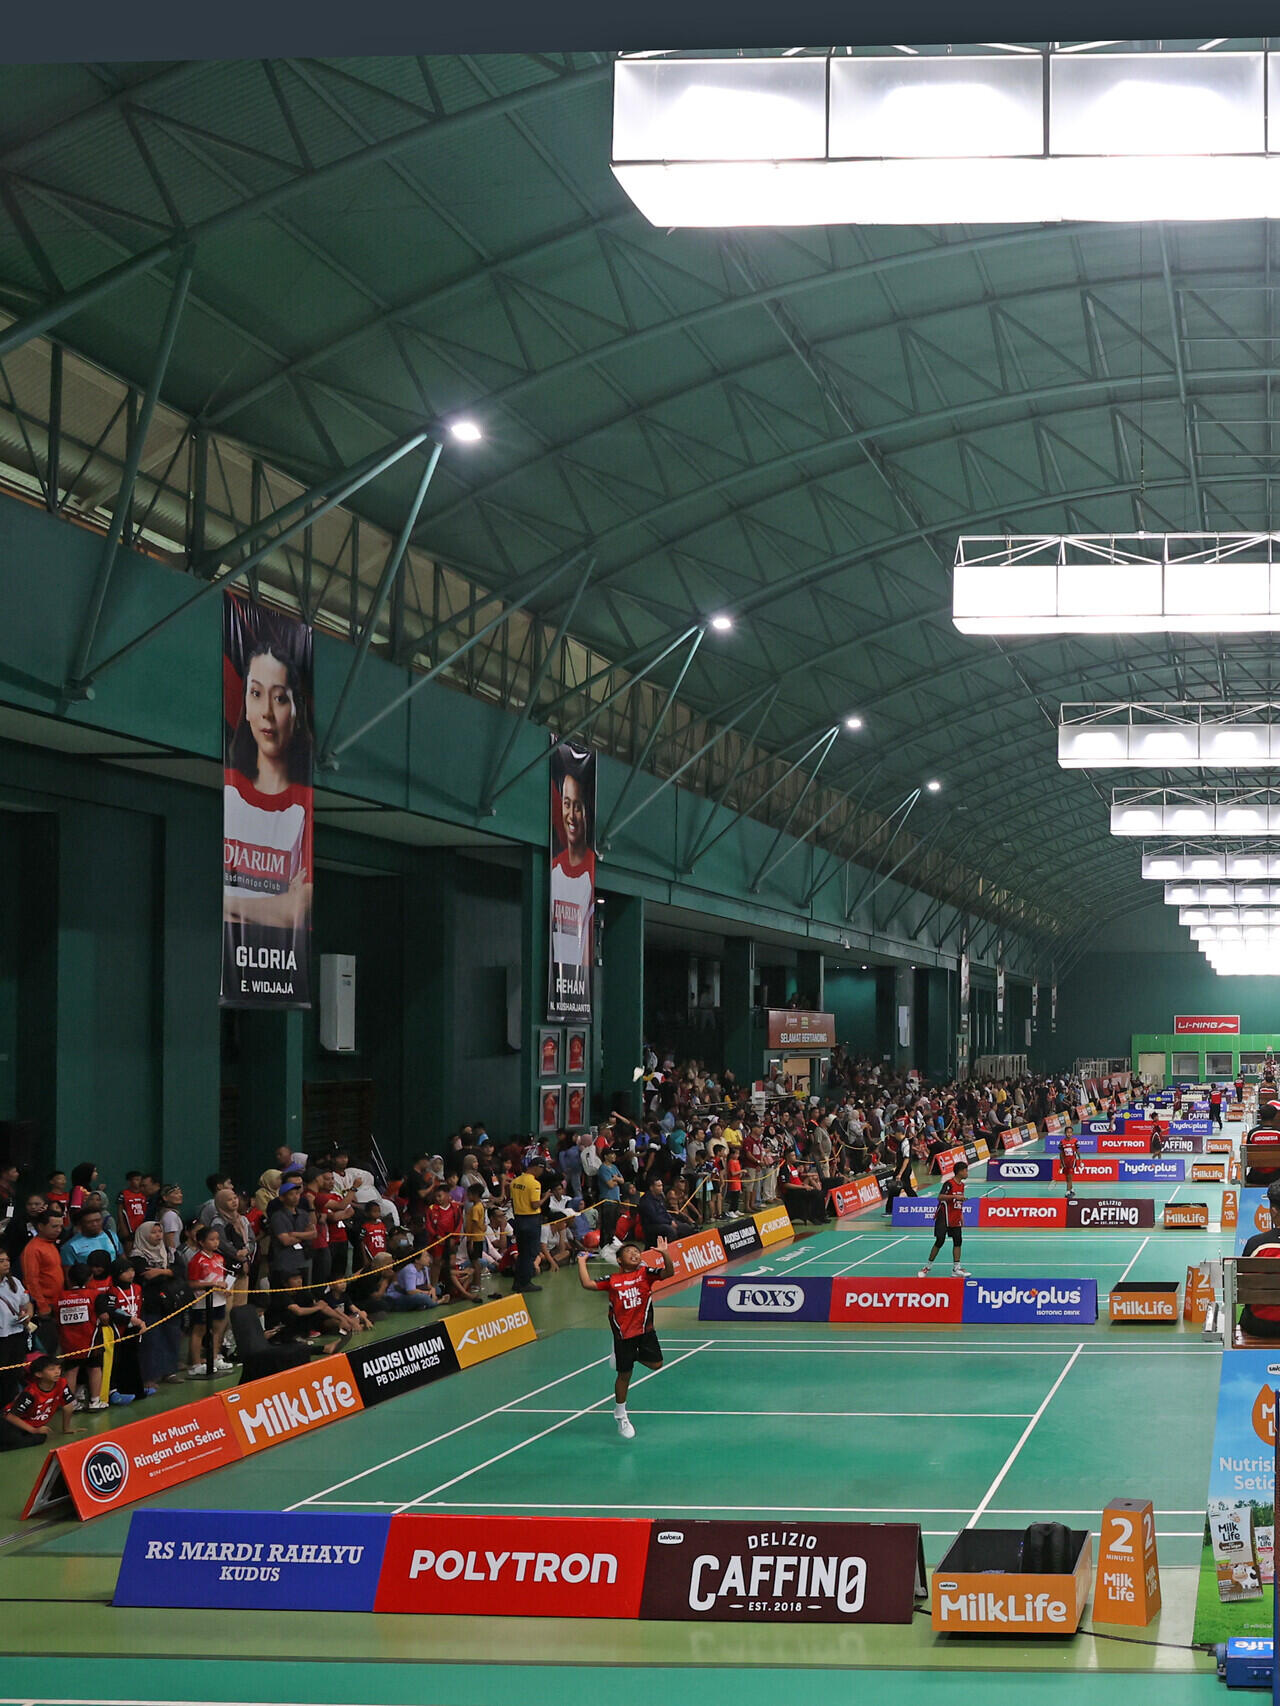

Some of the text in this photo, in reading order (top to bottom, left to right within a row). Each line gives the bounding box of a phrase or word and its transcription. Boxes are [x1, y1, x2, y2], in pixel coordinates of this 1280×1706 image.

[236, 945, 297, 971] GLORIA
[252, 980, 294, 995] WIDJAJA
[556, 978, 585, 996] REHAN
[1177, 1021, 1218, 1029] LI-NING
[1102, 1140, 1145, 1148] POLYTRON
[1125, 1162, 1176, 1175] hydroplus
[1225, 1193, 1234, 1204] 2
[988, 1207, 1057, 1217] POLYTRON
[1080, 1207, 1139, 1225] CAFFINO
[1166, 1213, 1206, 1224] MilkLife
[682, 1239, 725, 1273] MilkLife
[1197, 1272, 1209, 1289] 2
[618, 1287, 641, 1300] Milk
[845, 1292, 949, 1308] POLYTRON
[977, 1286, 1080, 1308] hydroplus
[623, 1297, 642, 1309] Life
[1113, 1301, 1173, 1316] MilkLife
[63, 1312, 84, 1321] 0787
[475, 1309, 530, 1343] HUNDRED
[362, 1335, 446, 1379] AUDISI UMUM
[376, 1354, 441, 1387] PB DJARUM 2025
[238, 1374, 356, 1445] MilkLife
[151, 1418, 200, 1446] Air Murni
[133, 1446, 173, 1468] Ringan
[173, 1438, 196, 1454] dan
[195, 1427, 227, 1447] Sehat
[1219, 1456, 1275, 1472] Nutrisi
[90, 1461, 122, 1486] Cleo
[1109, 1517, 1133, 1554] 2
[1143, 1513, 1153, 1551] 2
[1218, 1522, 1239, 1534] Milk
[1222, 1531, 1241, 1542] Life
[747, 1531, 818, 1551] DELIZIO
[144, 1540, 365, 1565] RS MARDI RAHAYU
[1106, 1553, 1135, 1563] MINUTES
[218, 1565, 281, 1582] KUDUS
[408, 1549, 619, 1584] POLYTRON
[688, 1554, 867, 1614] CAFFINO
[1103, 1571, 1134, 1589] Milk
[1108, 1586, 1135, 1603] Life
[940, 1592, 1068, 1623] MilkLife
